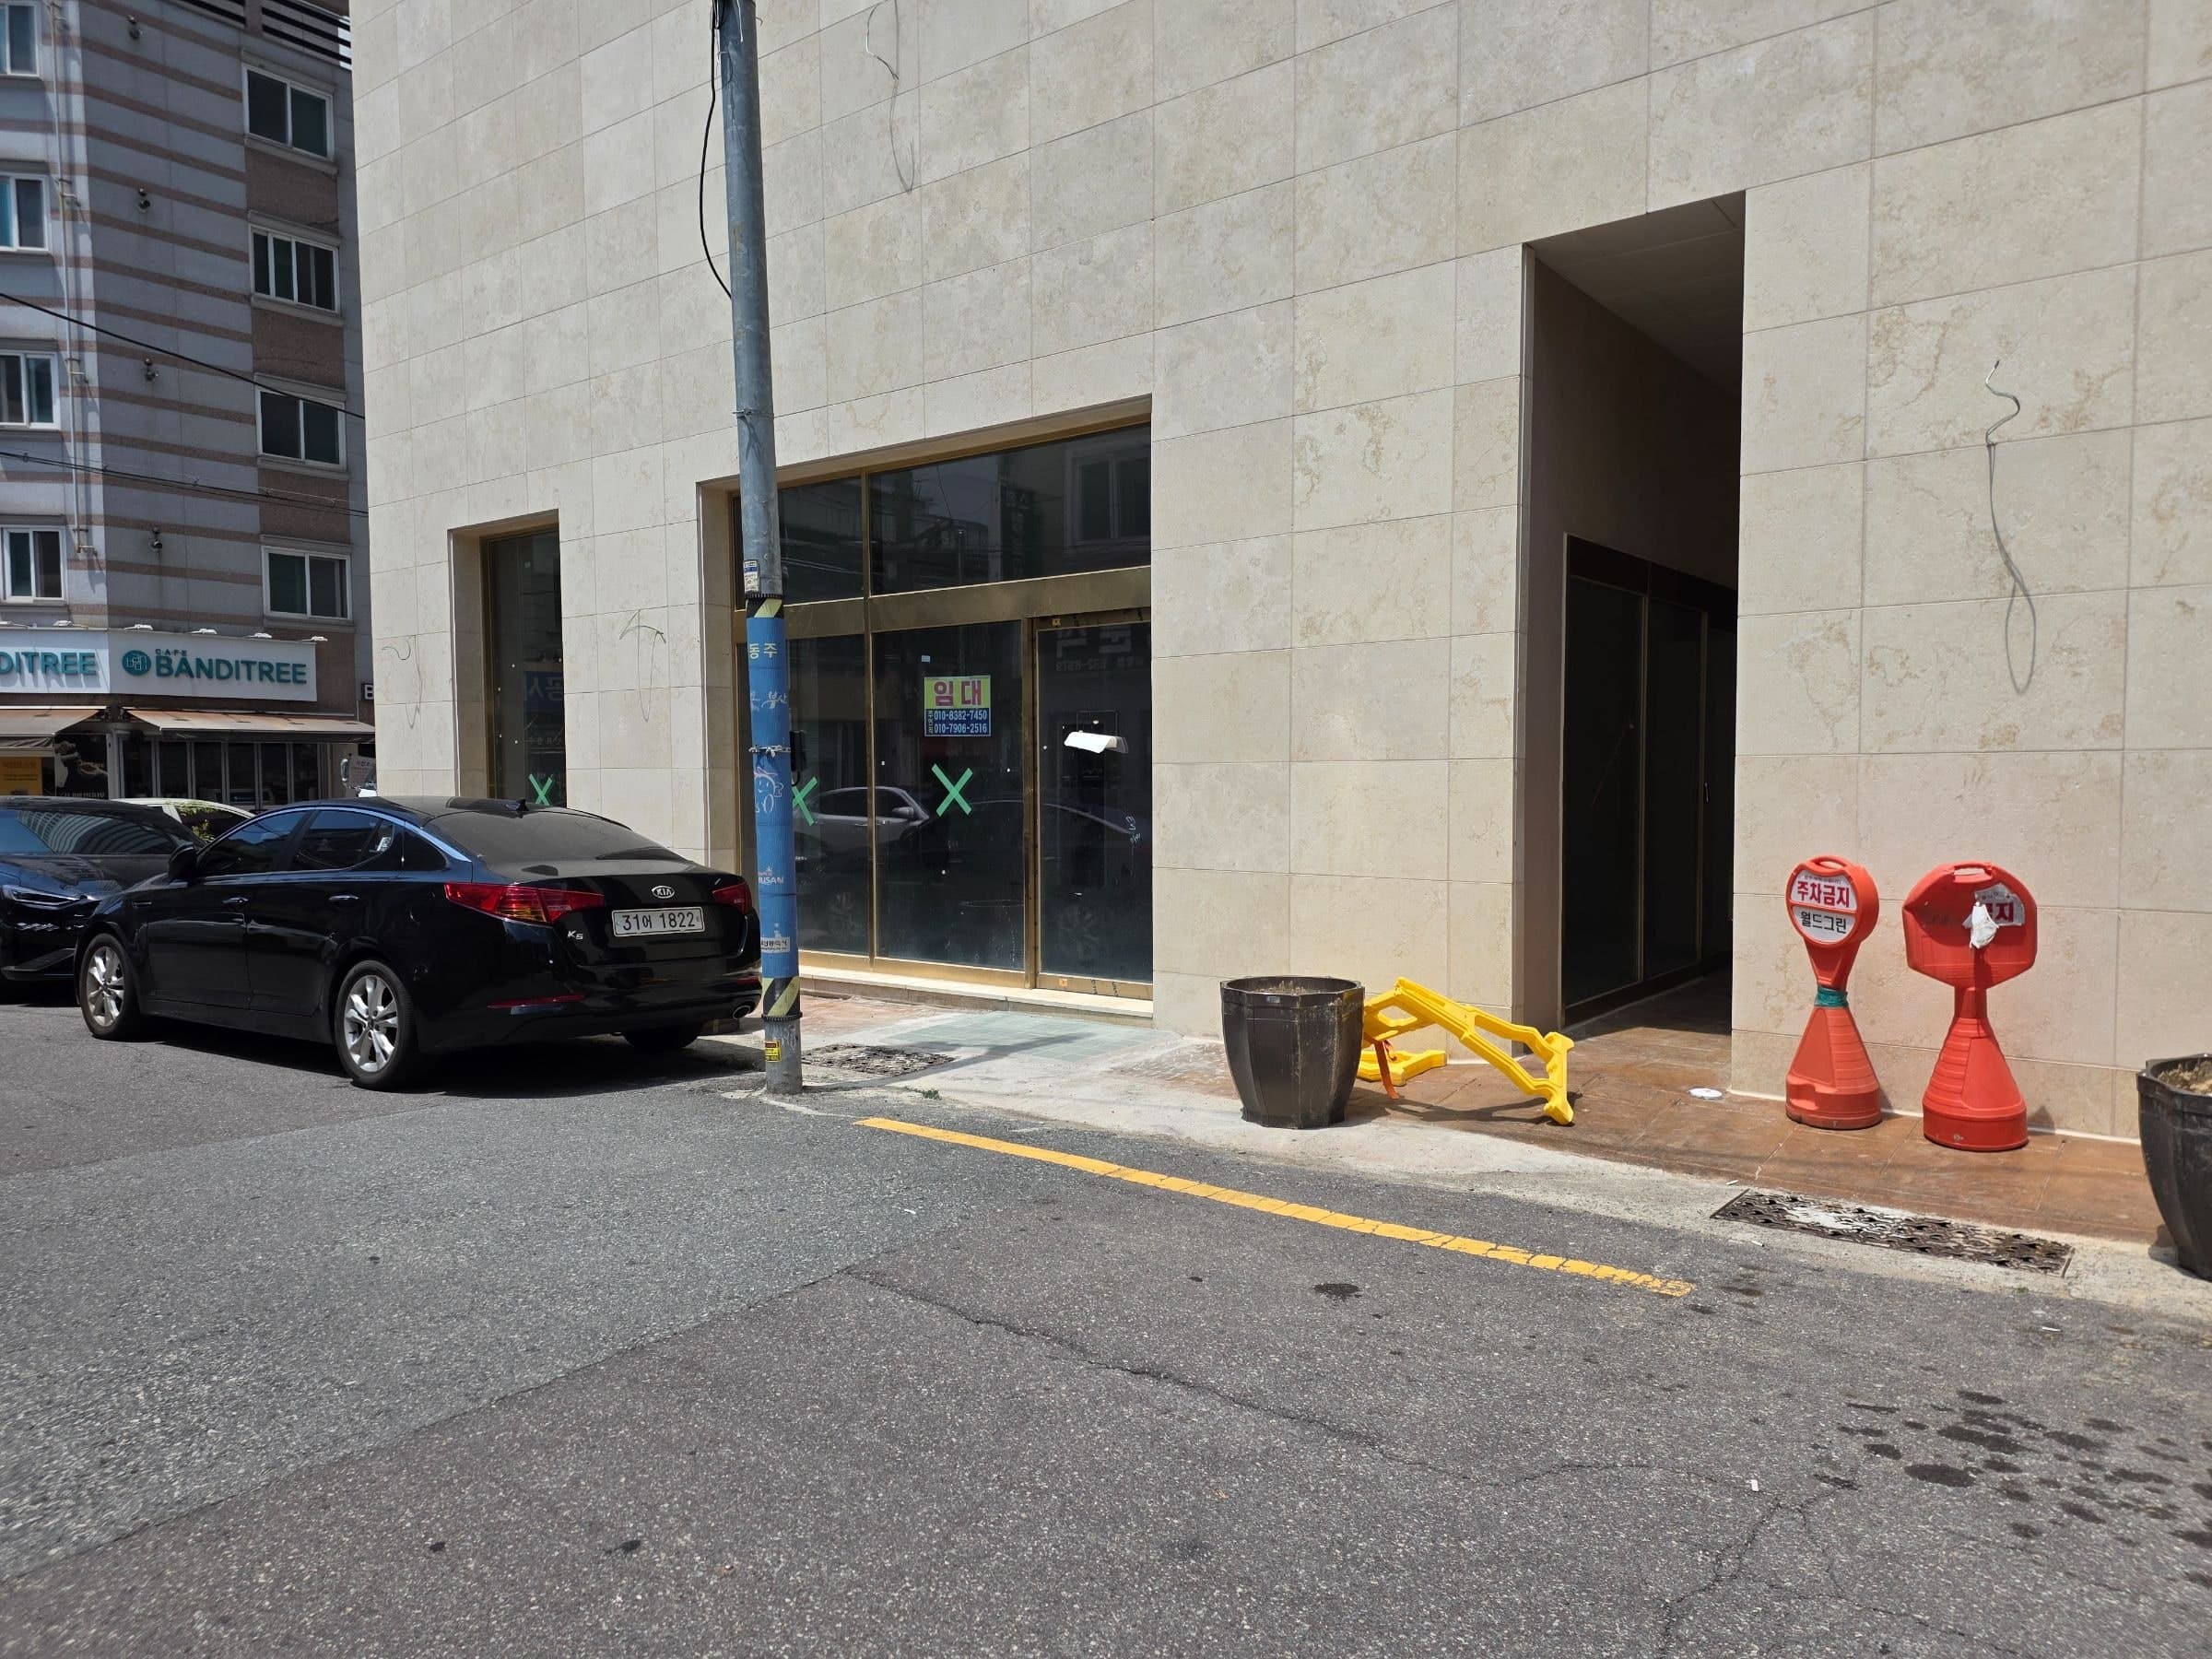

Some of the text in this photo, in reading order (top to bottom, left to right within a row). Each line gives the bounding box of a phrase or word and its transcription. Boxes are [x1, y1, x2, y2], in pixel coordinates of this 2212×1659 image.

[934, 710, 987, 721] 010-8382-7450
[934, 724, 987, 734] 010-7906-2516
[1797, 881, 1850, 908] 주차금지
[621, 912, 695, 931] 31어 1822
[1800, 912, 1847, 934] 월드그린
